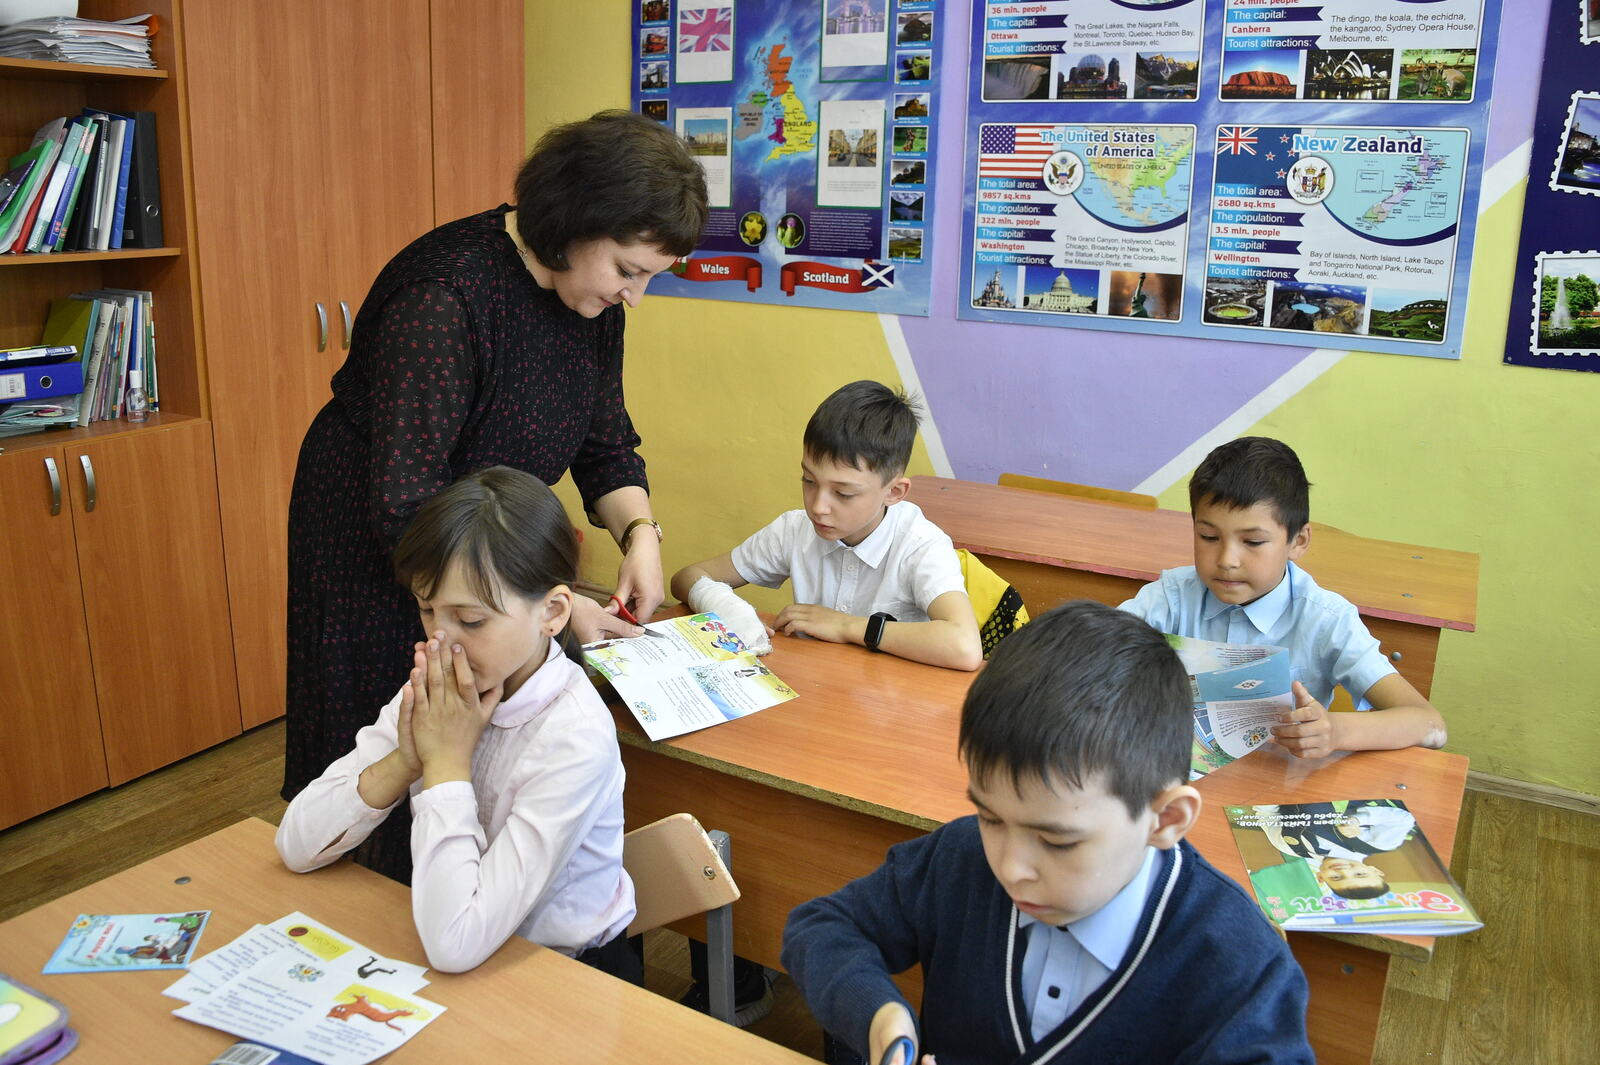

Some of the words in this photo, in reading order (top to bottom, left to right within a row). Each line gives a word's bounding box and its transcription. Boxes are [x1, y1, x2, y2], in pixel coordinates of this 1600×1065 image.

[1022, 5, 1047, 14] people
[1232, 11, 1250, 20] The
[1253, 10, 1287, 20] capital:
[992, 19, 1008, 27] The
[1009, 18, 1038, 28] capital:
[1347, 15, 1372, 24] dingo,
[1389, 14, 1414, 22] koala,
[1430, 12, 1466, 21] echidna,
[1232, 25, 1271, 34] Canberra
[1344, 25, 1384, 34] kangaroo,
[1386, 24, 1416, 33] Sydney
[1418, 23, 1444, 32] Opera
[1446, 22, 1476, 31] House,
[1228, 38, 1259, 48] Tourist
[1260, 38, 1312, 48] attractions:
[1329, 34, 1373, 43] Melbourne,
[988, 45, 1014, 53] Tourist
[1016, 44, 1060, 52] attractions:
[1040, 131, 1063, 142] The
[1067, 130, 1109, 142] United
[1113, 132, 1156, 143] States
[1294, 135, 1338, 151] New
[1343, 136, 1422, 154] Zealand
[1086, 145, 1098, 156] of
[1102, 146, 1154, 158] America
[982, 179, 998, 188] The
[998, 180, 1016, 189] total
[982, 192, 1002, 200] 9857
[1003, 192, 1032, 202] sq.kms
[1217, 186, 1236, 196] The
[1237, 186, 1256, 196] total
[1258, 188, 1282, 198] area:
[982, 204, 998, 212] The
[998, 204, 1040, 215] population:
[1218, 199, 1241, 208] 2680
[1244, 200, 1276, 210] sq.kms
[981, 218, 996, 226] 322
[1016, 218, 1041, 227] people
[1216, 212, 1236, 222] The
[1237, 214, 1286, 226] population:
[981, 228, 998, 238] The
[998, 228, 1026, 239] capital:
[1216, 226, 1229, 235] 3.5
[1252, 228, 1280, 238] people
[980, 242, 1025, 252] Washington
[1216, 239, 1234, 248] The
[1235, 240, 1268, 252] capital:
[977, 253, 1002, 262] Tourist
[1004, 254, 1048, 265] attractions:
[1214, 253, 1260, 264] Wellington
[1310, 250, 1322, 258] Bay
[1332, 252, 1358, 260] Islands,
[1380, 255, 1402, 263] Island,
[1424, 258, 1444, 266] Taupo
[700, 263, 730, 276] Wales
[1210, 266, 1240, 276] Tourist
[1242, 268, 1291, 279] attractions:
[1323, 261, 1354, 270] Tongariro
[1356, 263, 1383, 271] National
[1384, 264, 1402, 272] Park,
[1404, 266, 1434, 275] Rotorua,
[803, 270, 850, 284] Scotland
[1332, 271, 1364, 280] Auckland,
